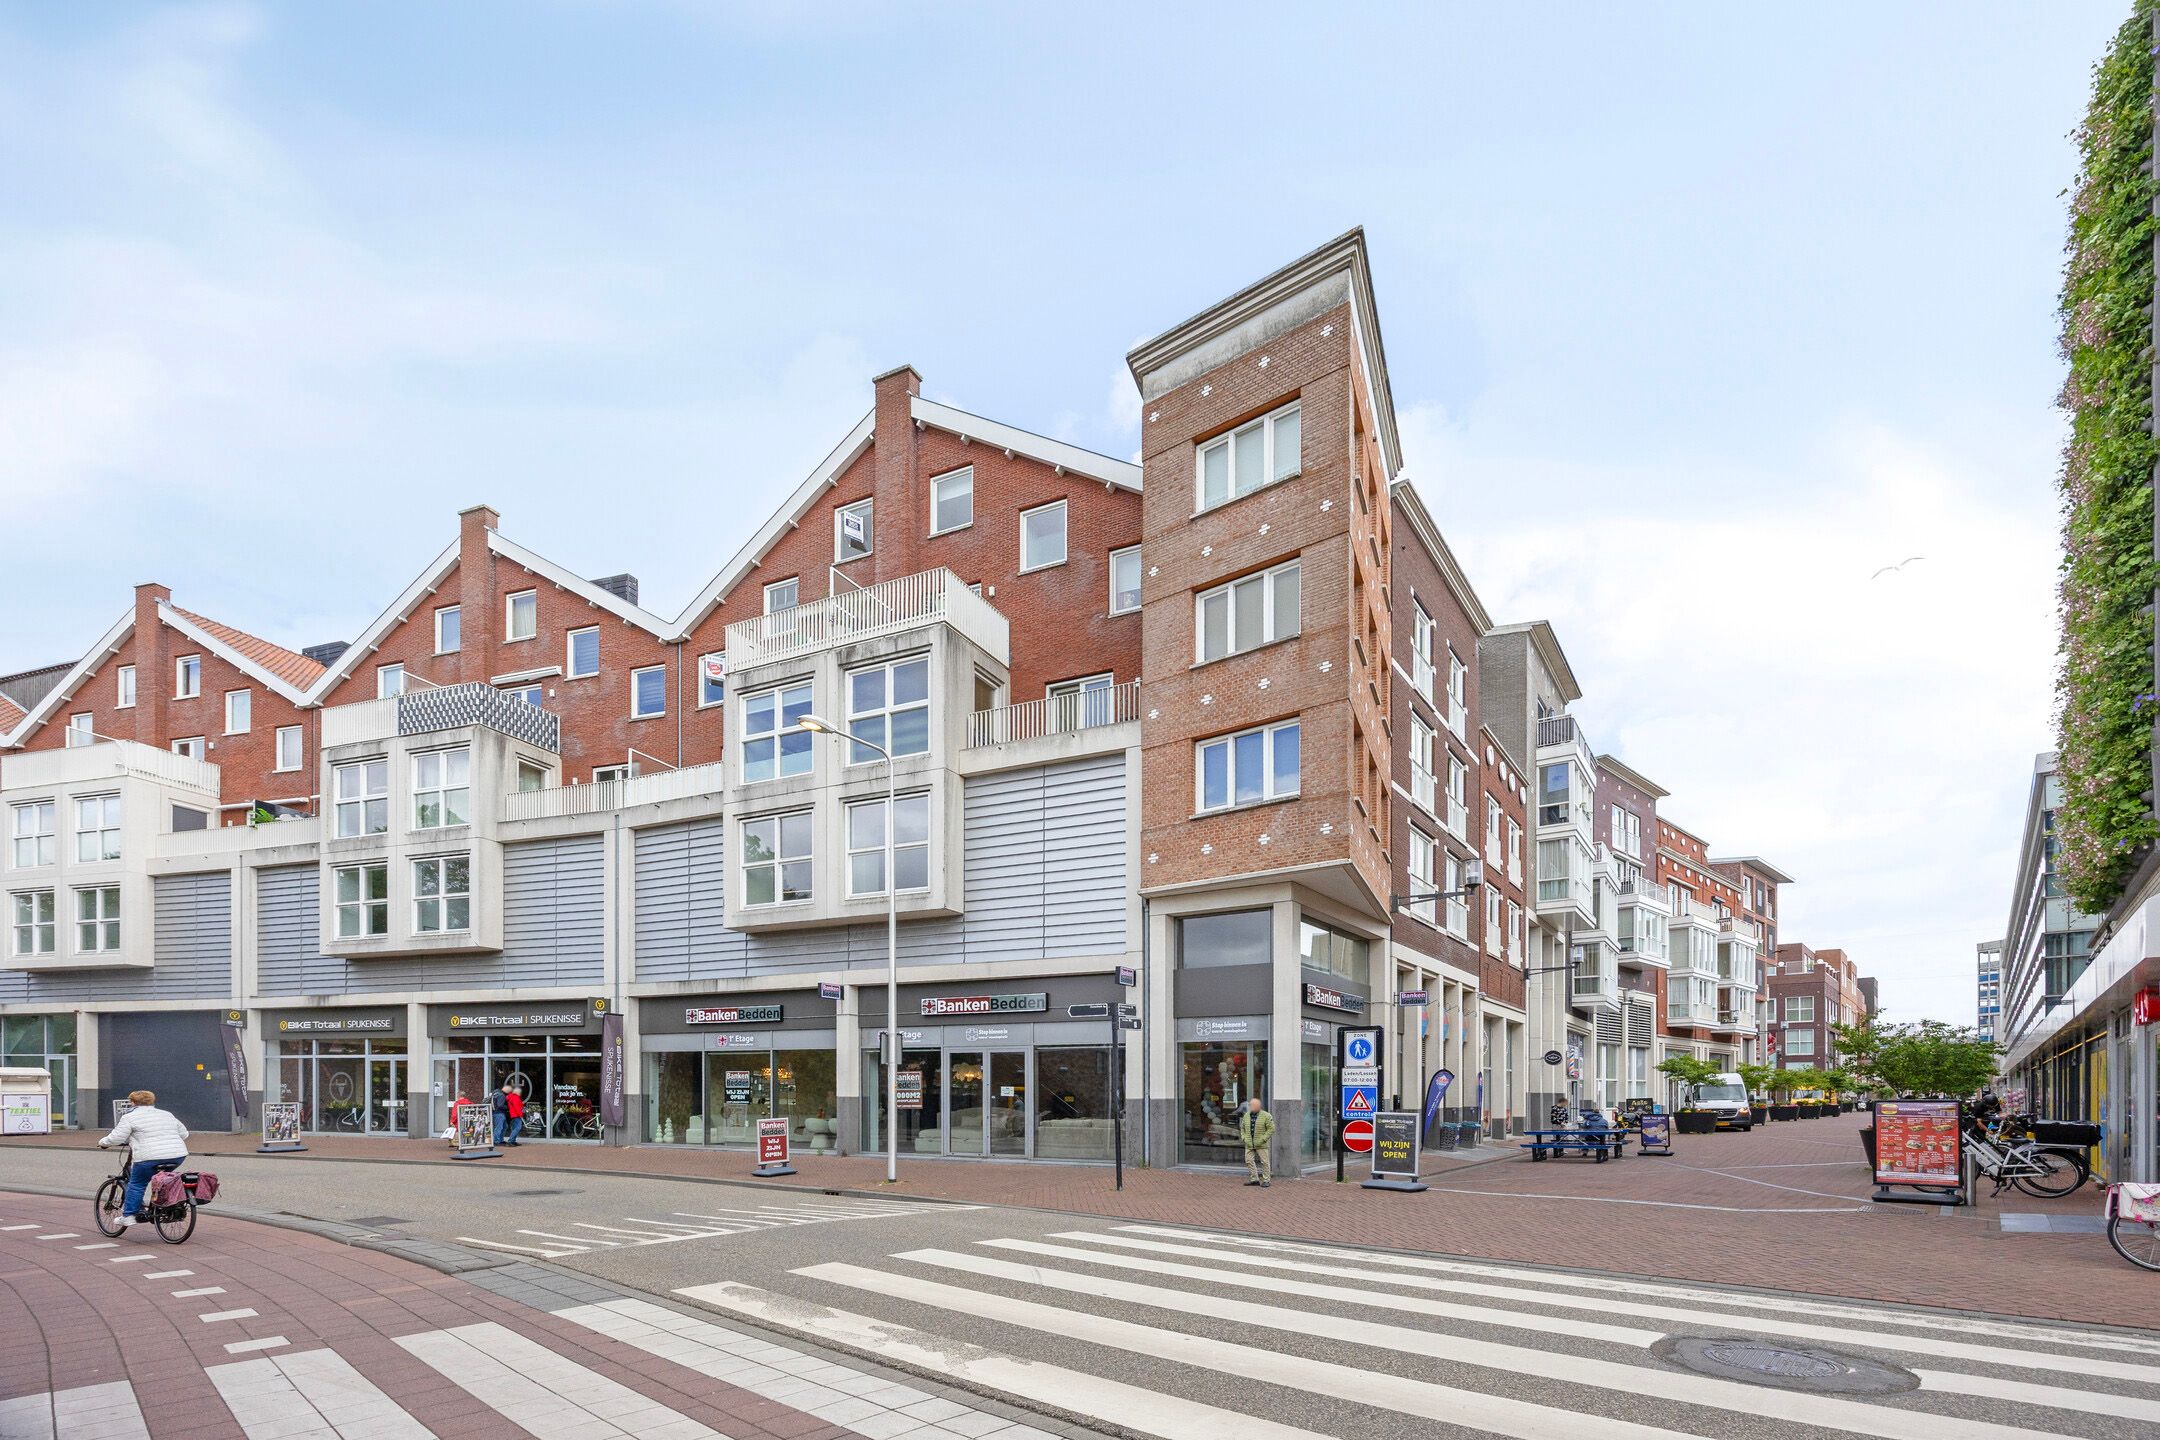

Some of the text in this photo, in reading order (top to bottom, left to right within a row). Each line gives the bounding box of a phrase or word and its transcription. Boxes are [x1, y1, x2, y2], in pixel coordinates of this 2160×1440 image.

[1316, 989, 1341, 1007] Banken
[937, 995, 1045, 1012] Banken Bedden
[698, 1008, 780, 1021] Banken Bedden
[287, 1021, 312, 1029] BIKE
[312, 1020, 341, 1029] Totaal
[460, 1016, 488, 1025] BIKE
[489, 1015, 523, 1024] Totaal
[735, 1034, 754, 1043] Etage
[898, 1073, 920, 1081] anken
[898, 1081, 920, 1089] edden
[760, 1121, 786, 1129] Banken
[761, 1128, 786, 1136] Bedden
[1379, 1140, 1411, 1149] WIJ ZIJN
[1382, 1150, 1407, 1159] OPEN!
